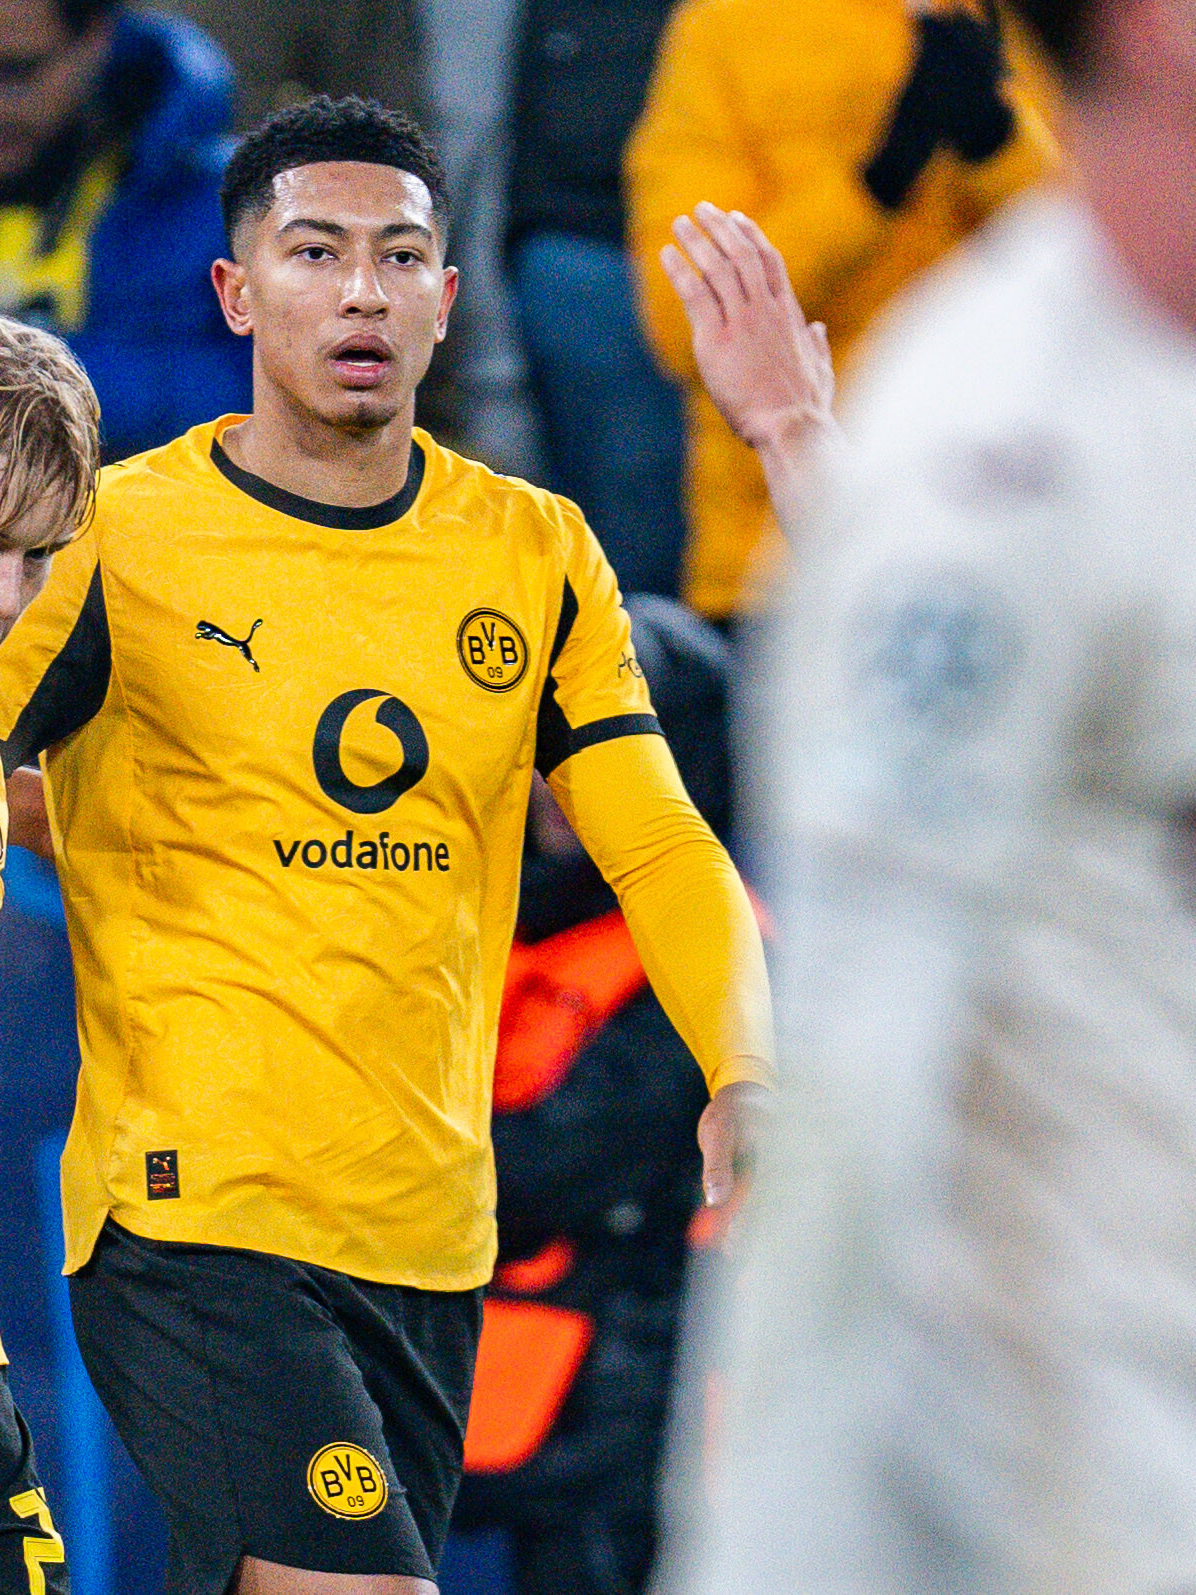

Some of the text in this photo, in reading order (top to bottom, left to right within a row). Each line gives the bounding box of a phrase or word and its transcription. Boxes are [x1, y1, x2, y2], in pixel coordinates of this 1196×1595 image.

[467, 621, 519, 665] BVB
[487, 666, 504, 679] 09
[272, 829, 451, 872] vodafone
[320, 1453, 377, 1498] BVB
[347, 1495, 365, 1508] 09
